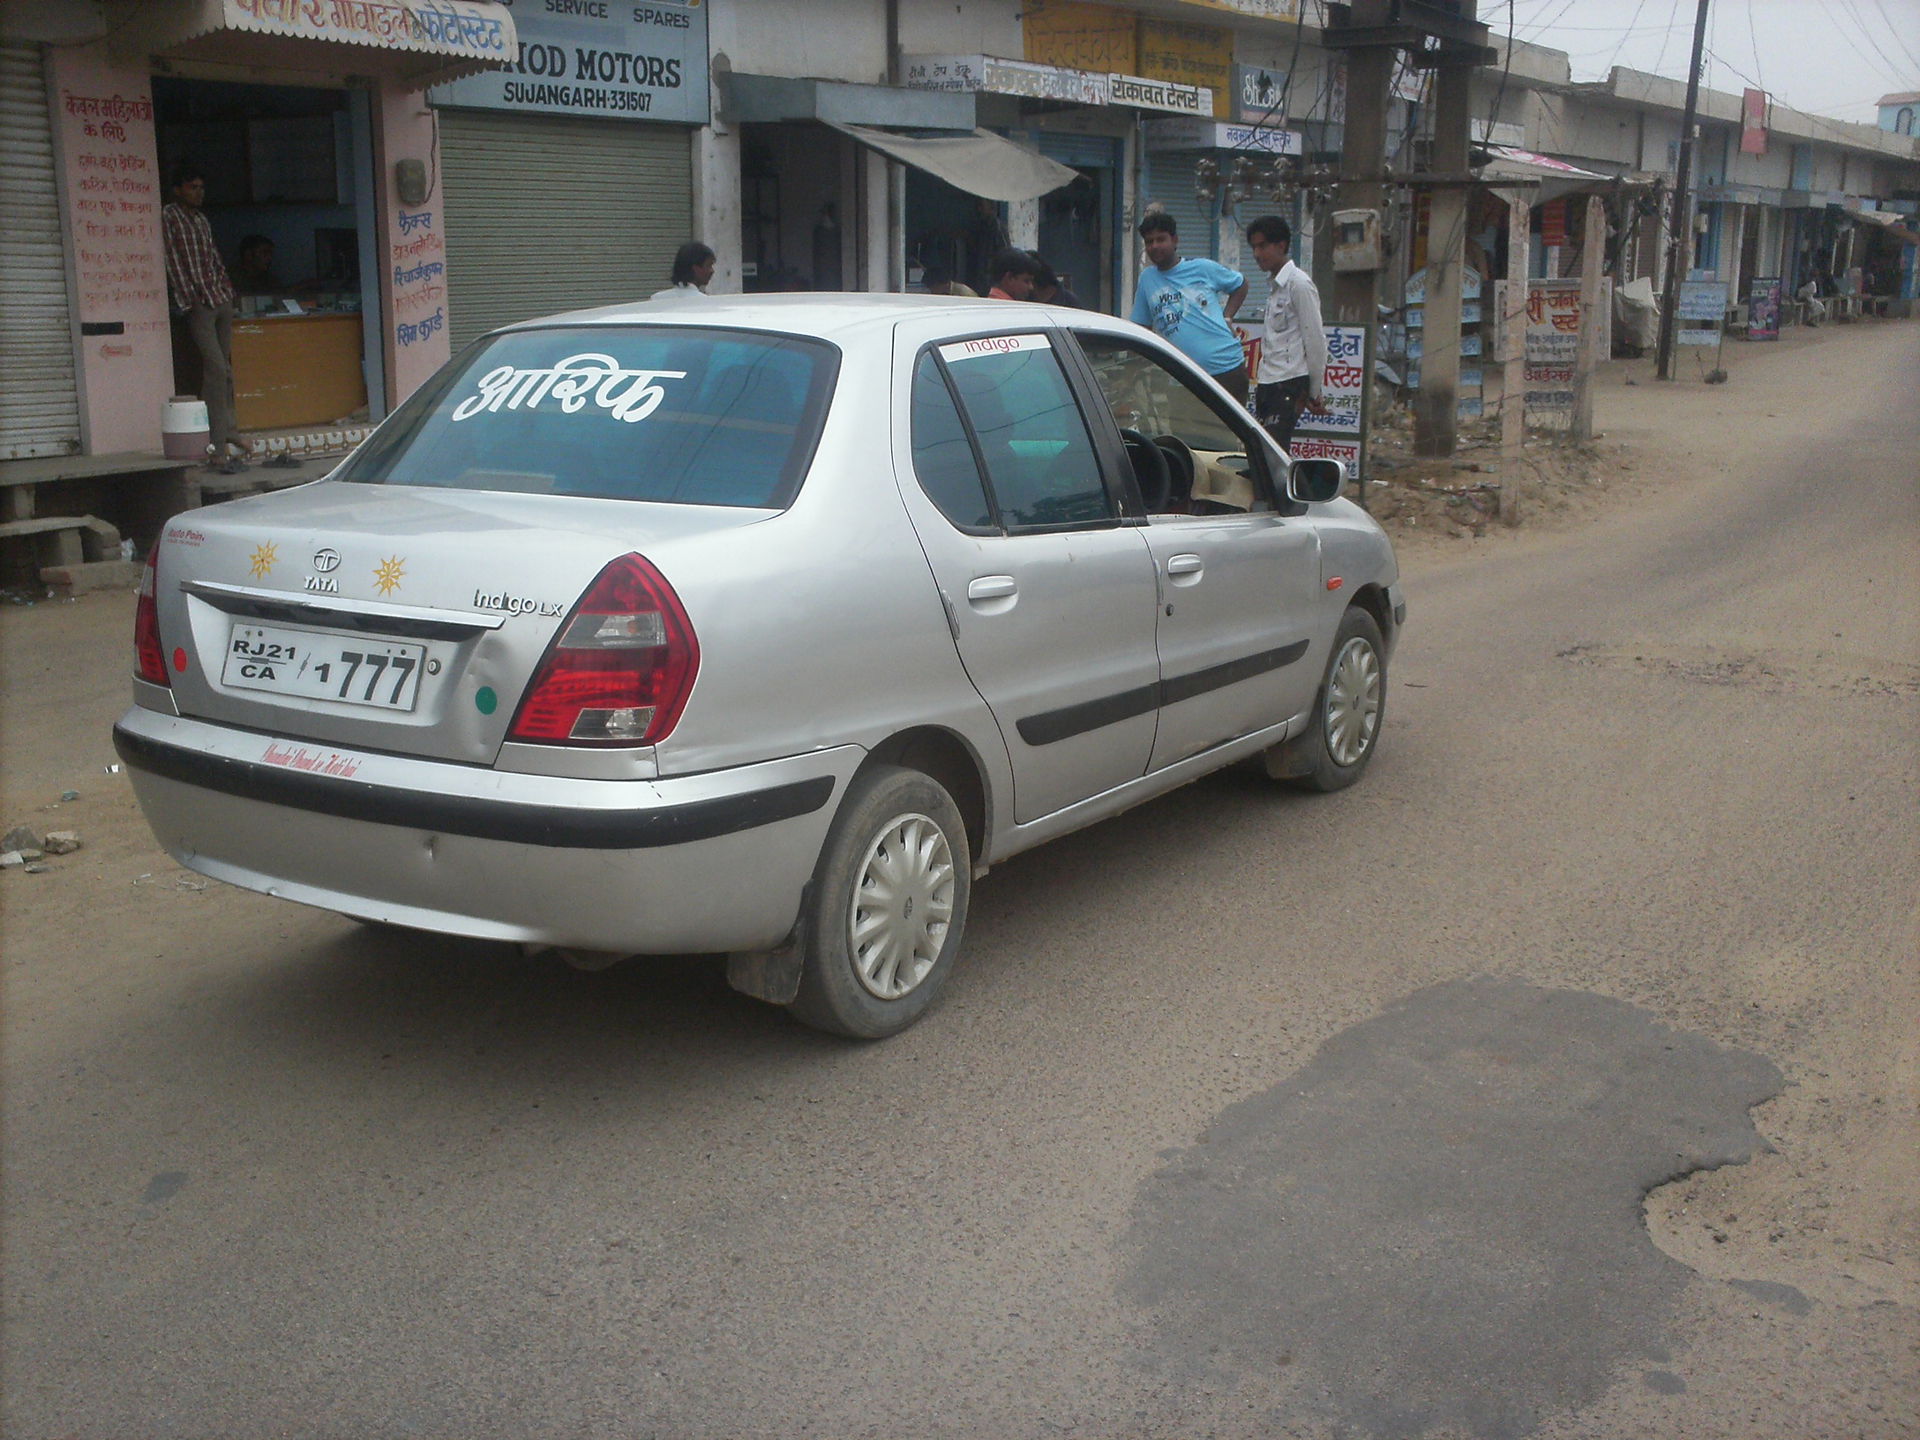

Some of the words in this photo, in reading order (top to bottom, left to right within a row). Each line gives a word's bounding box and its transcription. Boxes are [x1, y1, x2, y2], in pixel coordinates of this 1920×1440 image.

[546, 0, 609, 19] SERVICE
[633, 8, 690, 29] SPARES
[504, 42, 567, 77] NOD
[576, 48, 682, 88] MOTORS
[451, 352, 688, 424] आरिफ
[304, 575, 340, 593] TATA
[538, 602, 564, 617] LX
[233, 640, 296, 660] RJ21
[240, 664, 276, 681] CA
[314, 651, 416, 704] 1777
